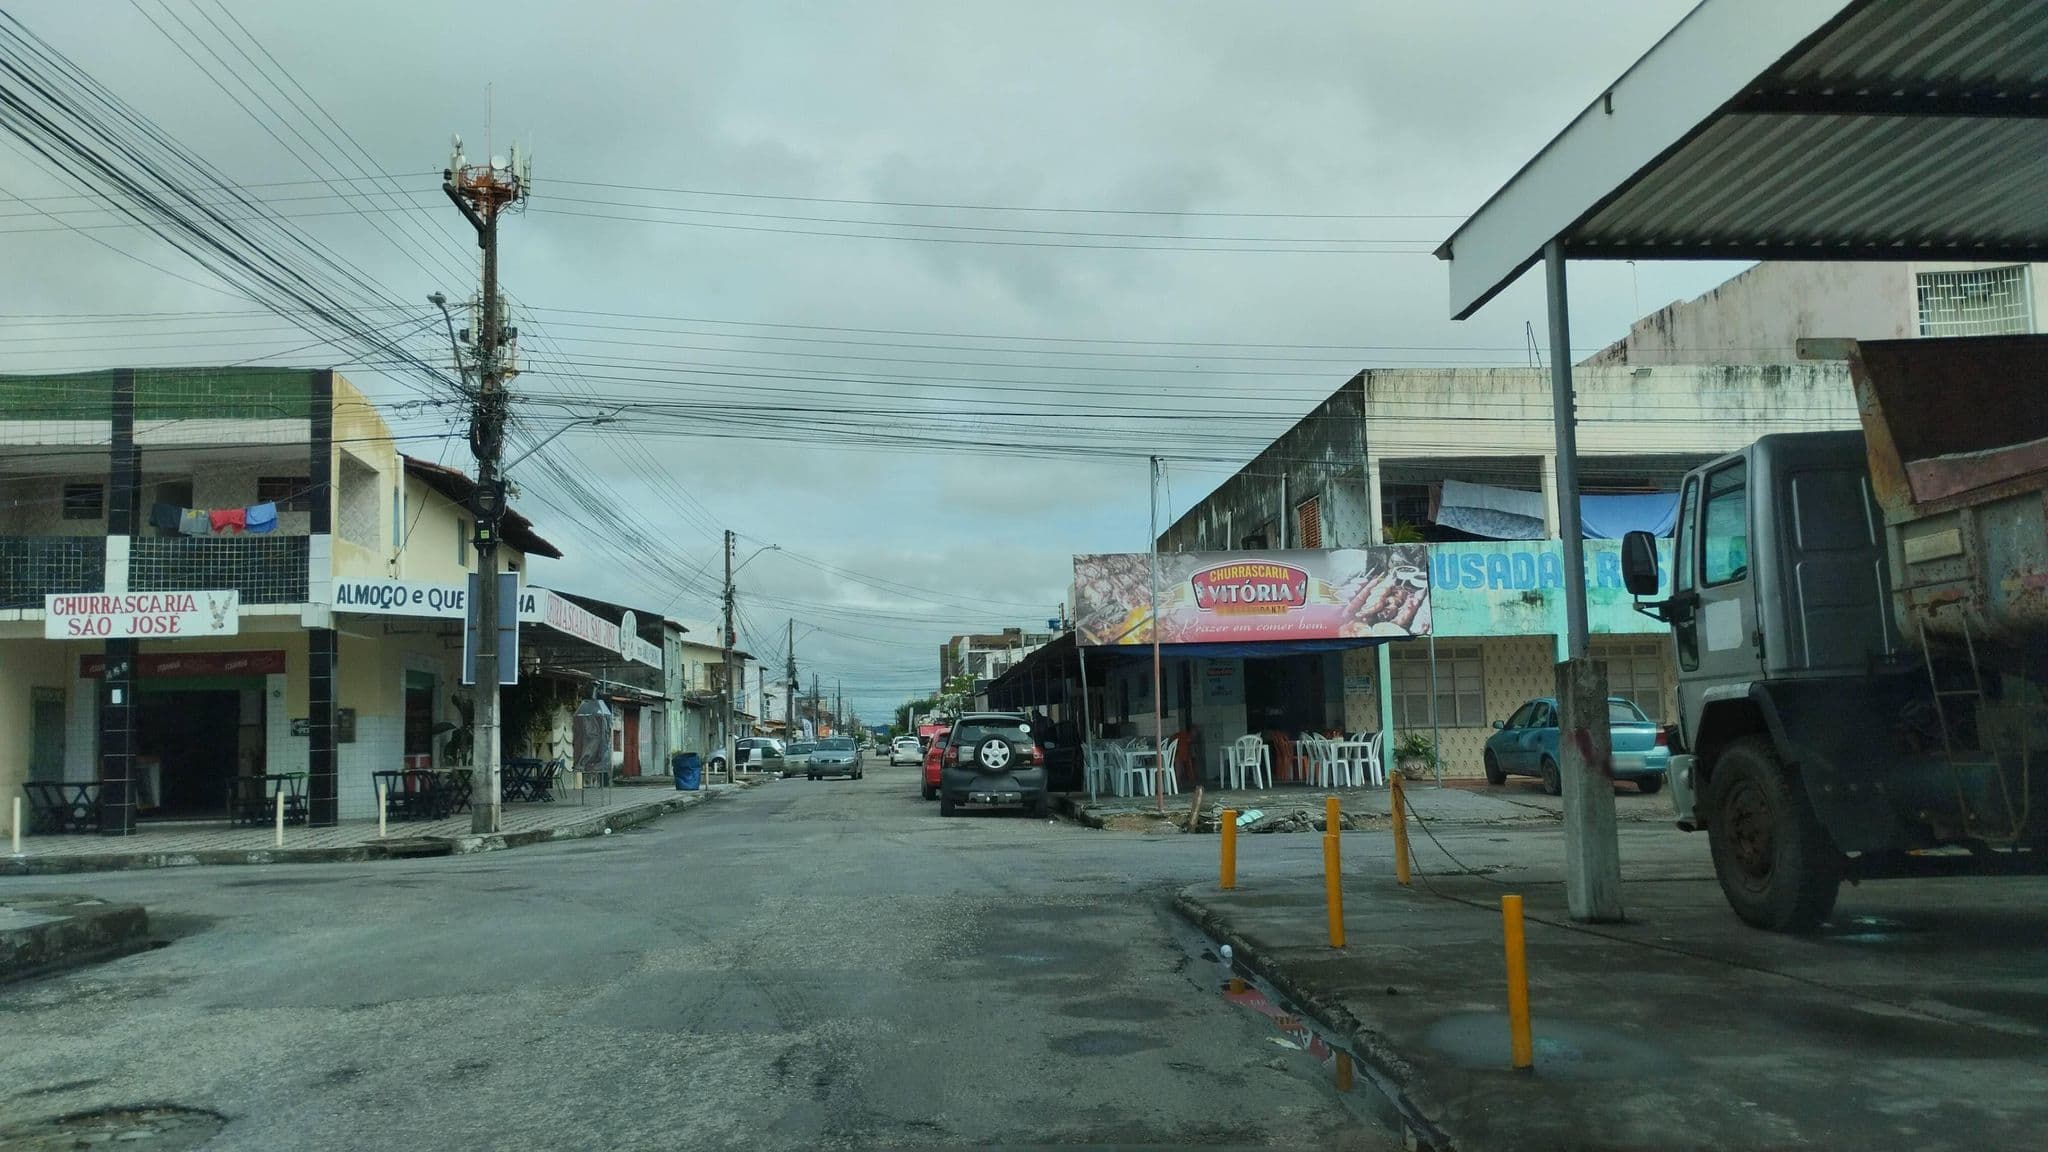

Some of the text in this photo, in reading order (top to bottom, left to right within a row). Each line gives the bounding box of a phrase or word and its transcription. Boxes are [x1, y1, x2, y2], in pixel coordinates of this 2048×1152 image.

[1210, 565, 1289, 582] CHURRASCARIA
[1428, 552, 1563, 590] USADA
[336, 584, 407, 609] ALMOÇO
[412, 589, 423, 604] e
[1208, 579, 1294, 604] VITÓRIA
[53, 594, 197, 616] CHURRASCARIA
[126, 612, 181, 635] JOSÉ
[1182, 616, 1230, 635] Prazer
[1233, 623, 1250, 632] em
[1256, 622, 1294, 632] comer
